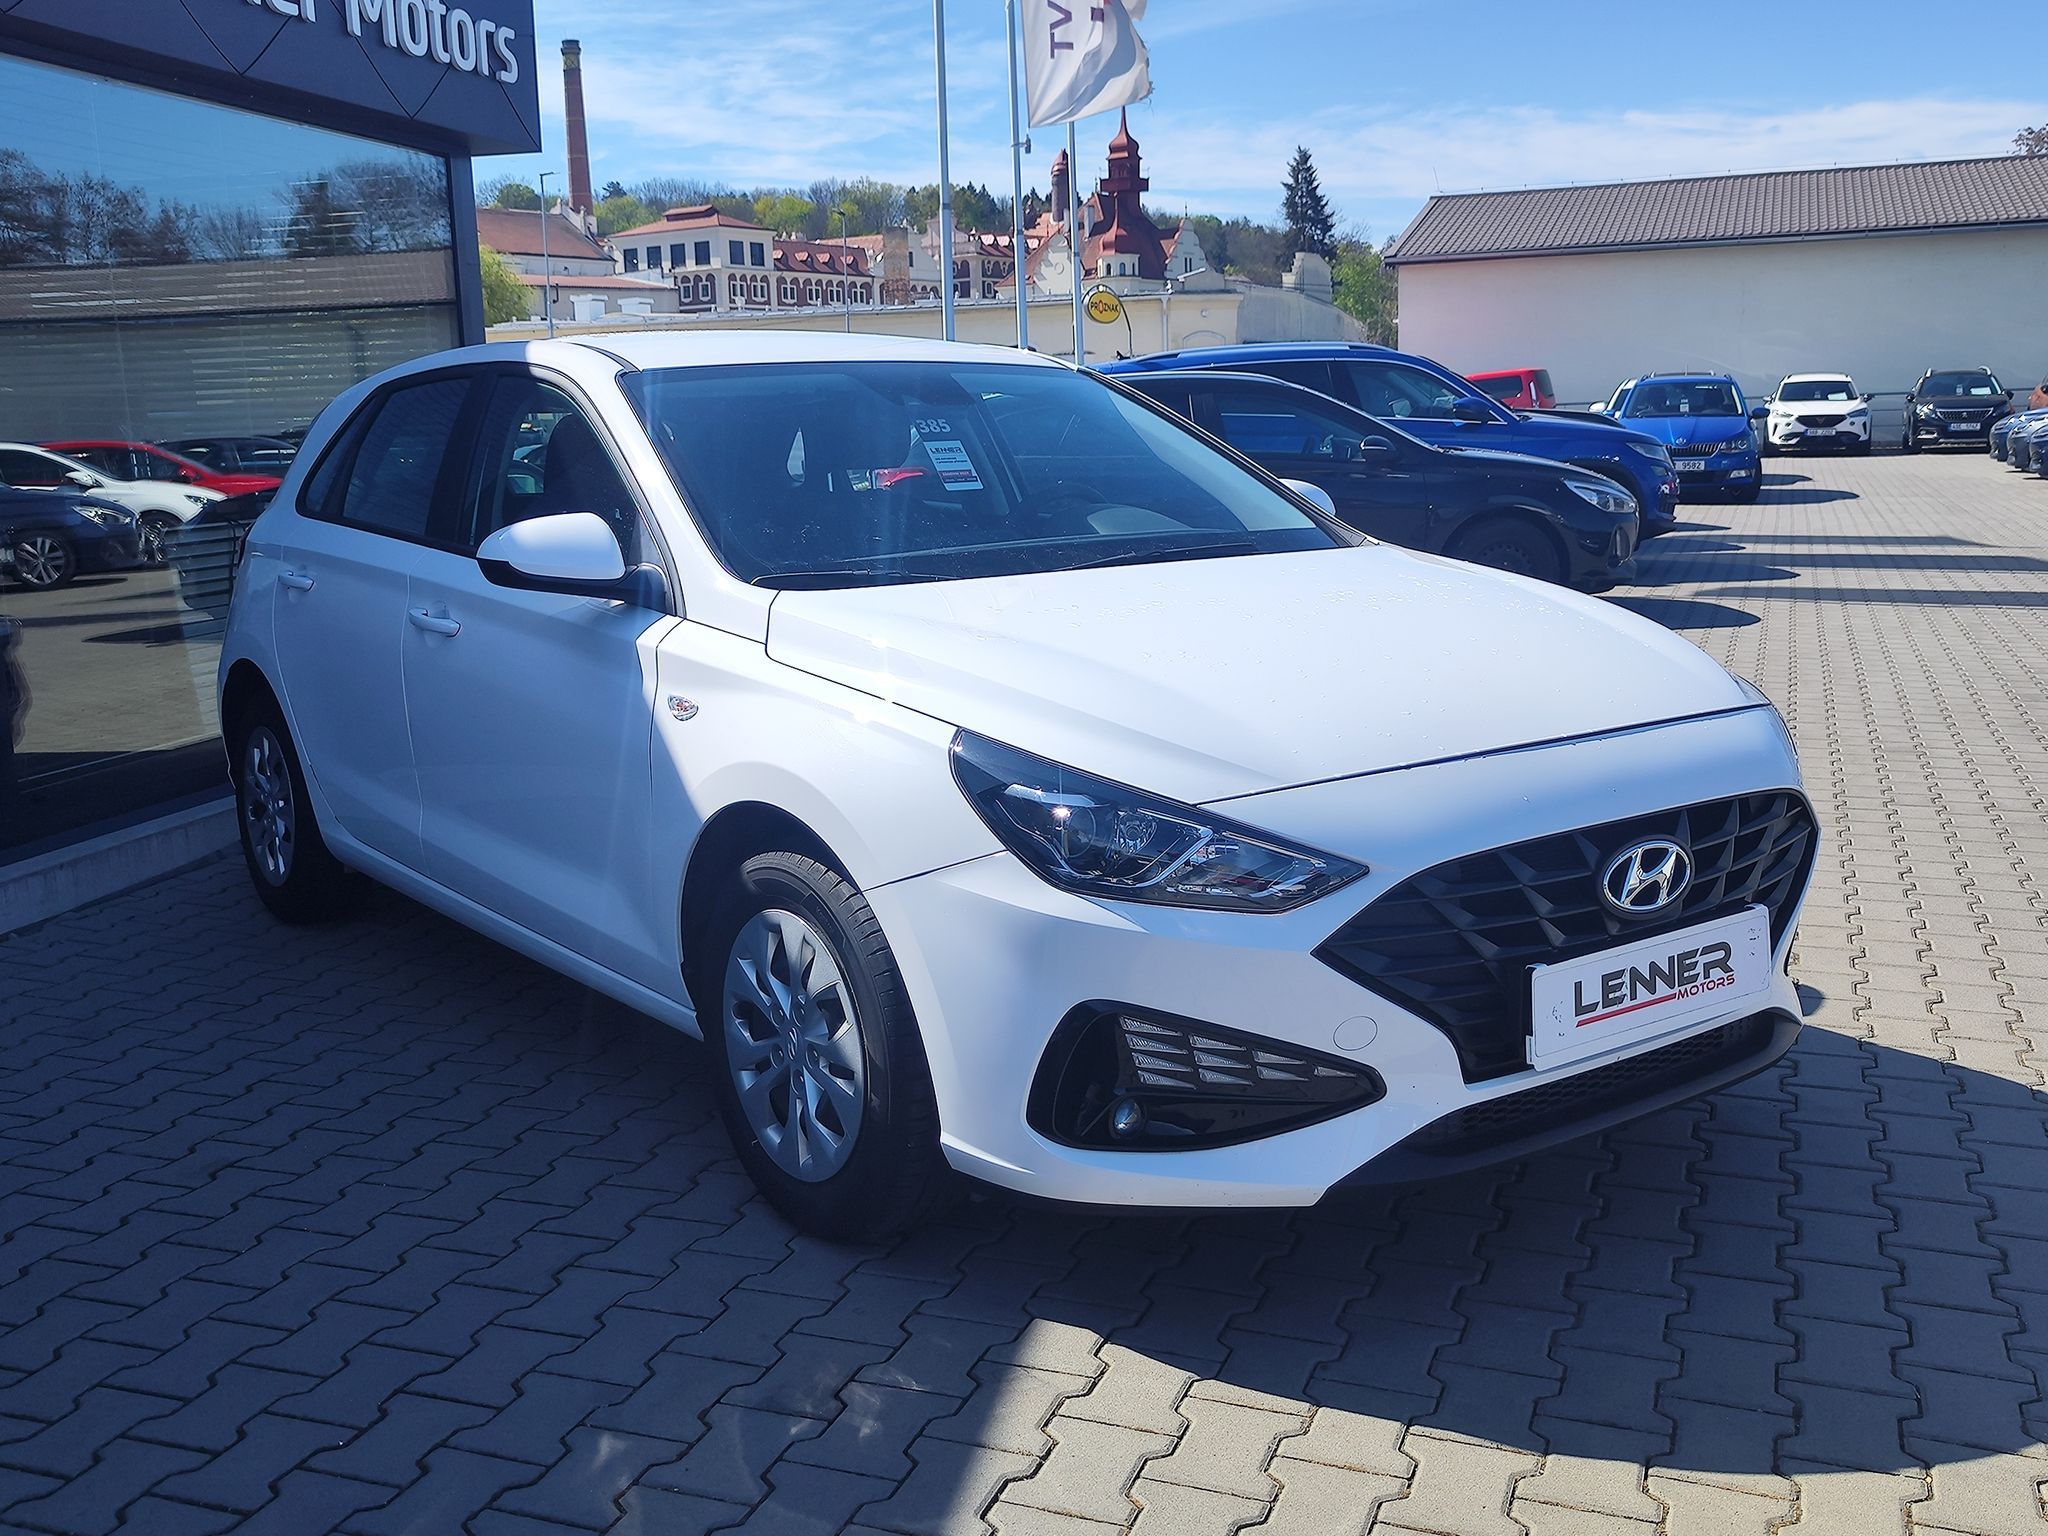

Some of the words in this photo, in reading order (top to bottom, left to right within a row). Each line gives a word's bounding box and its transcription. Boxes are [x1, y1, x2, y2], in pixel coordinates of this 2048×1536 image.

[1090, 299, 1119, 314] PROZNAK
[916, 418, 951, 434] 385
[1681, 460, 1702, 470] 9582
[1573, 941, 1735, 1018] LENNER
[1676, 974, 1736, 1001] MOTORS
